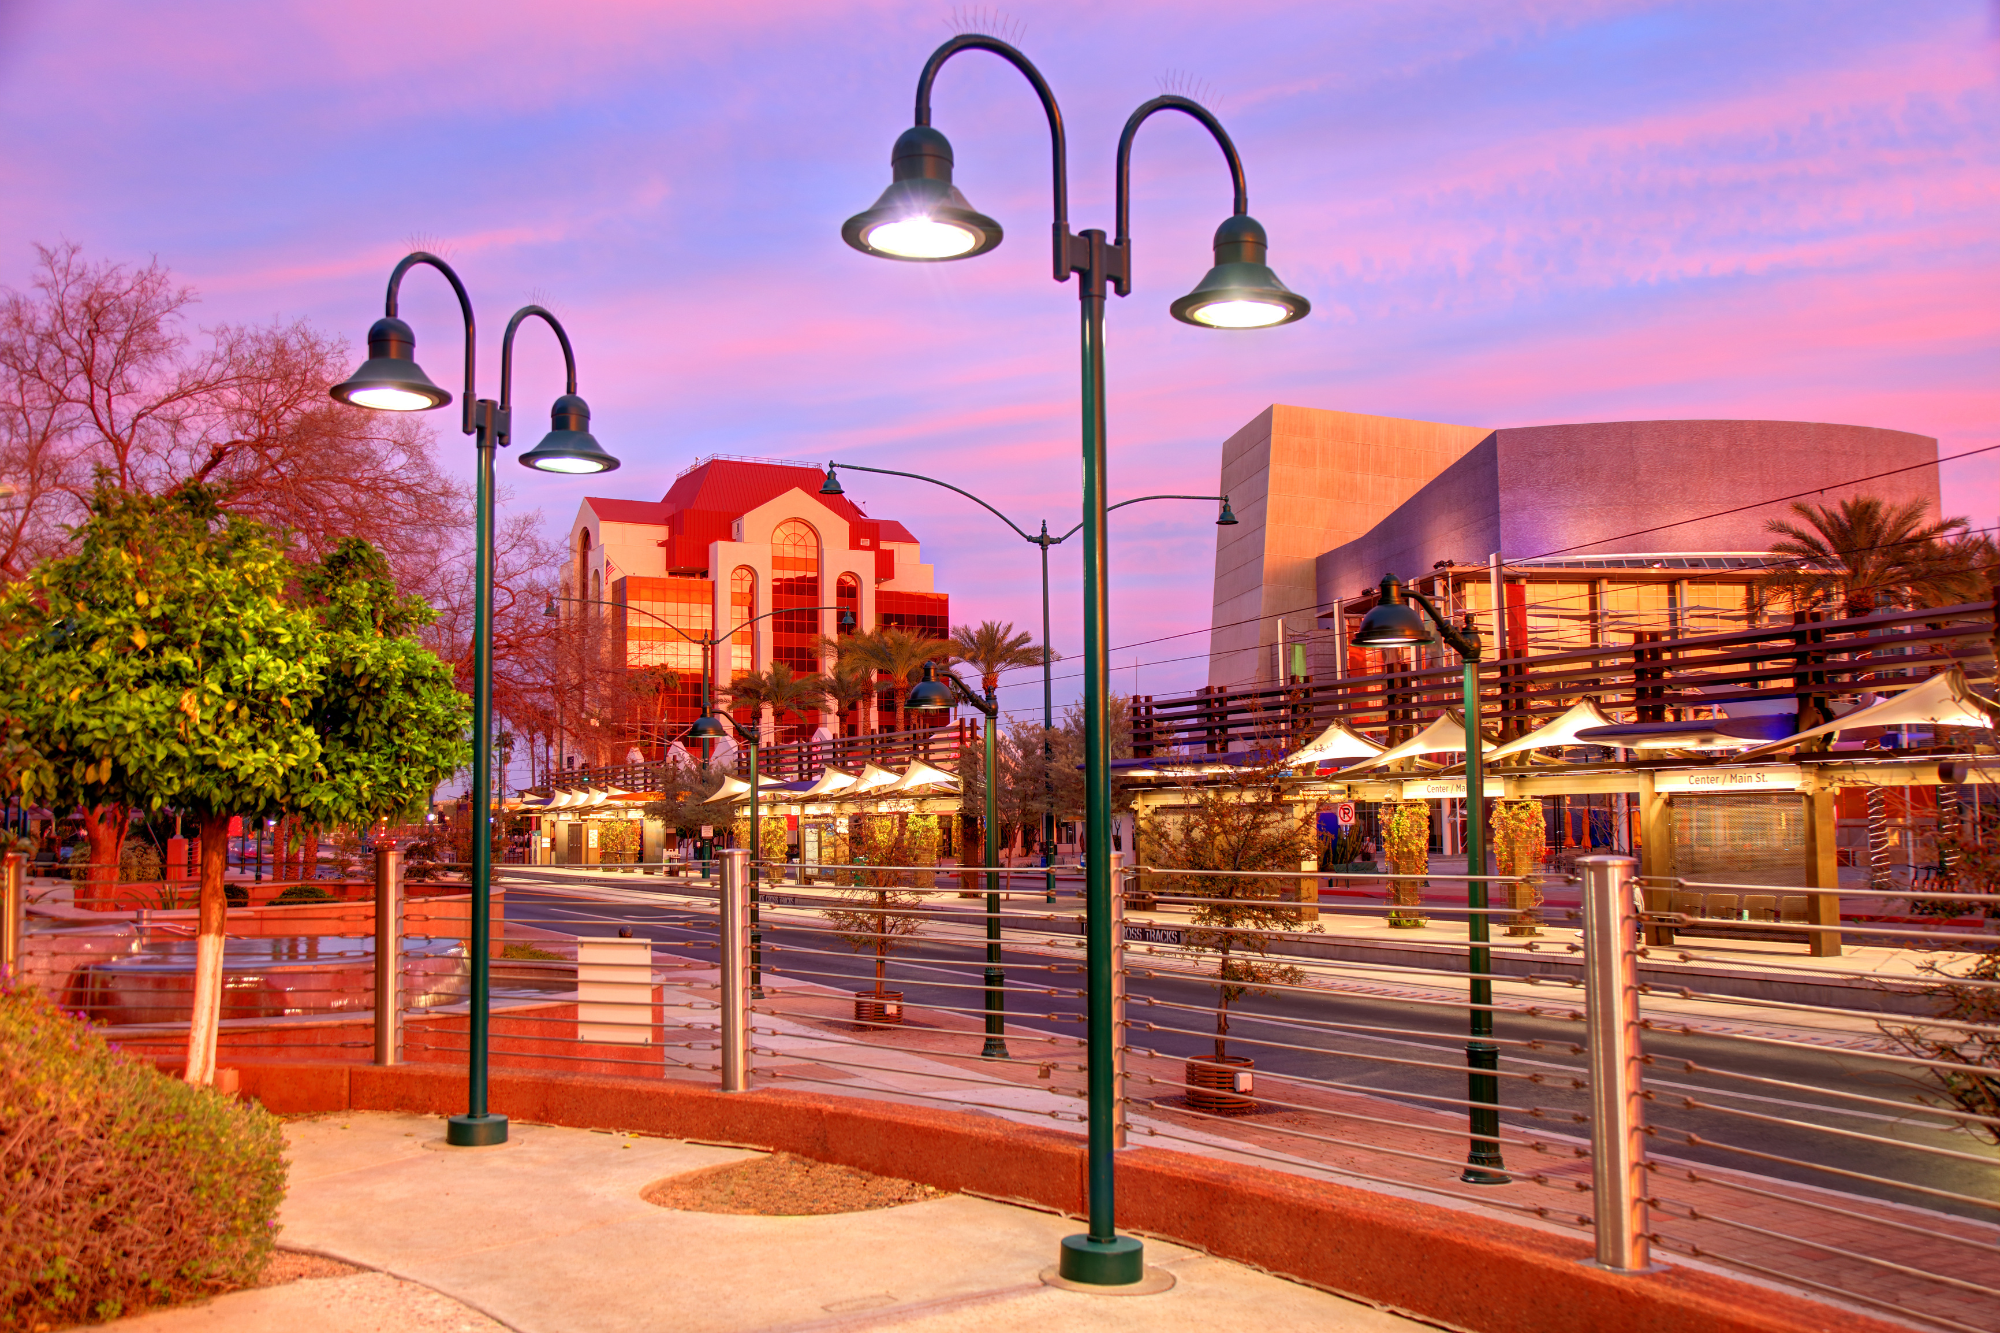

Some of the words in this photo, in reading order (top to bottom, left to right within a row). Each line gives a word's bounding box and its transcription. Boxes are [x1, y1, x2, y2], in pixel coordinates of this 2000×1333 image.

[1689, 774, 1719, 785] Center
[1730, 773, 1752, 784] Main
[1755, 772, 1768, 783] St.
[1426, 784, 1449, 793] Center
[1456, 784, 1466, 793] Ma
[1124, 926, 1142, 940] OSS
[1145, 928, 1178, 944] TRACKS
